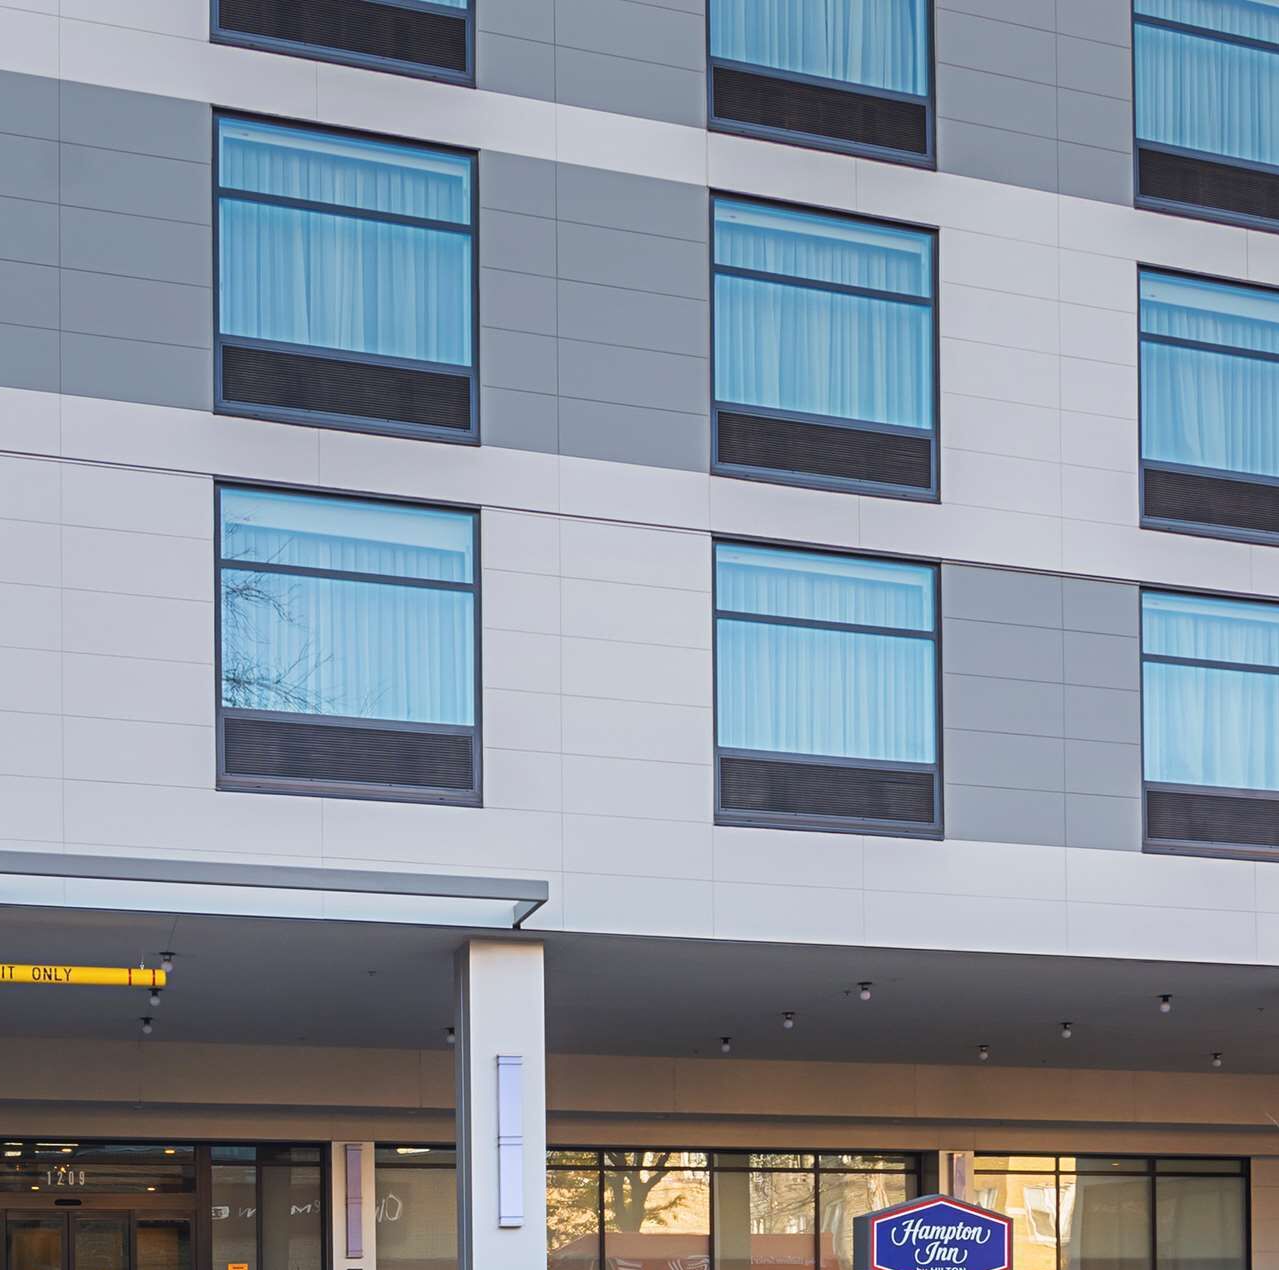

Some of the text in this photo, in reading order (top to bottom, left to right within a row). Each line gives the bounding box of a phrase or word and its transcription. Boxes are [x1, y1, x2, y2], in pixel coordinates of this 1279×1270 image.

[31, 966, 72, 982] ONLY
[46, 1170, 86, 1186] 1209
[891, 1217, 991, 1246] Hampton
[914, 1241, 969, 1265] Inn
